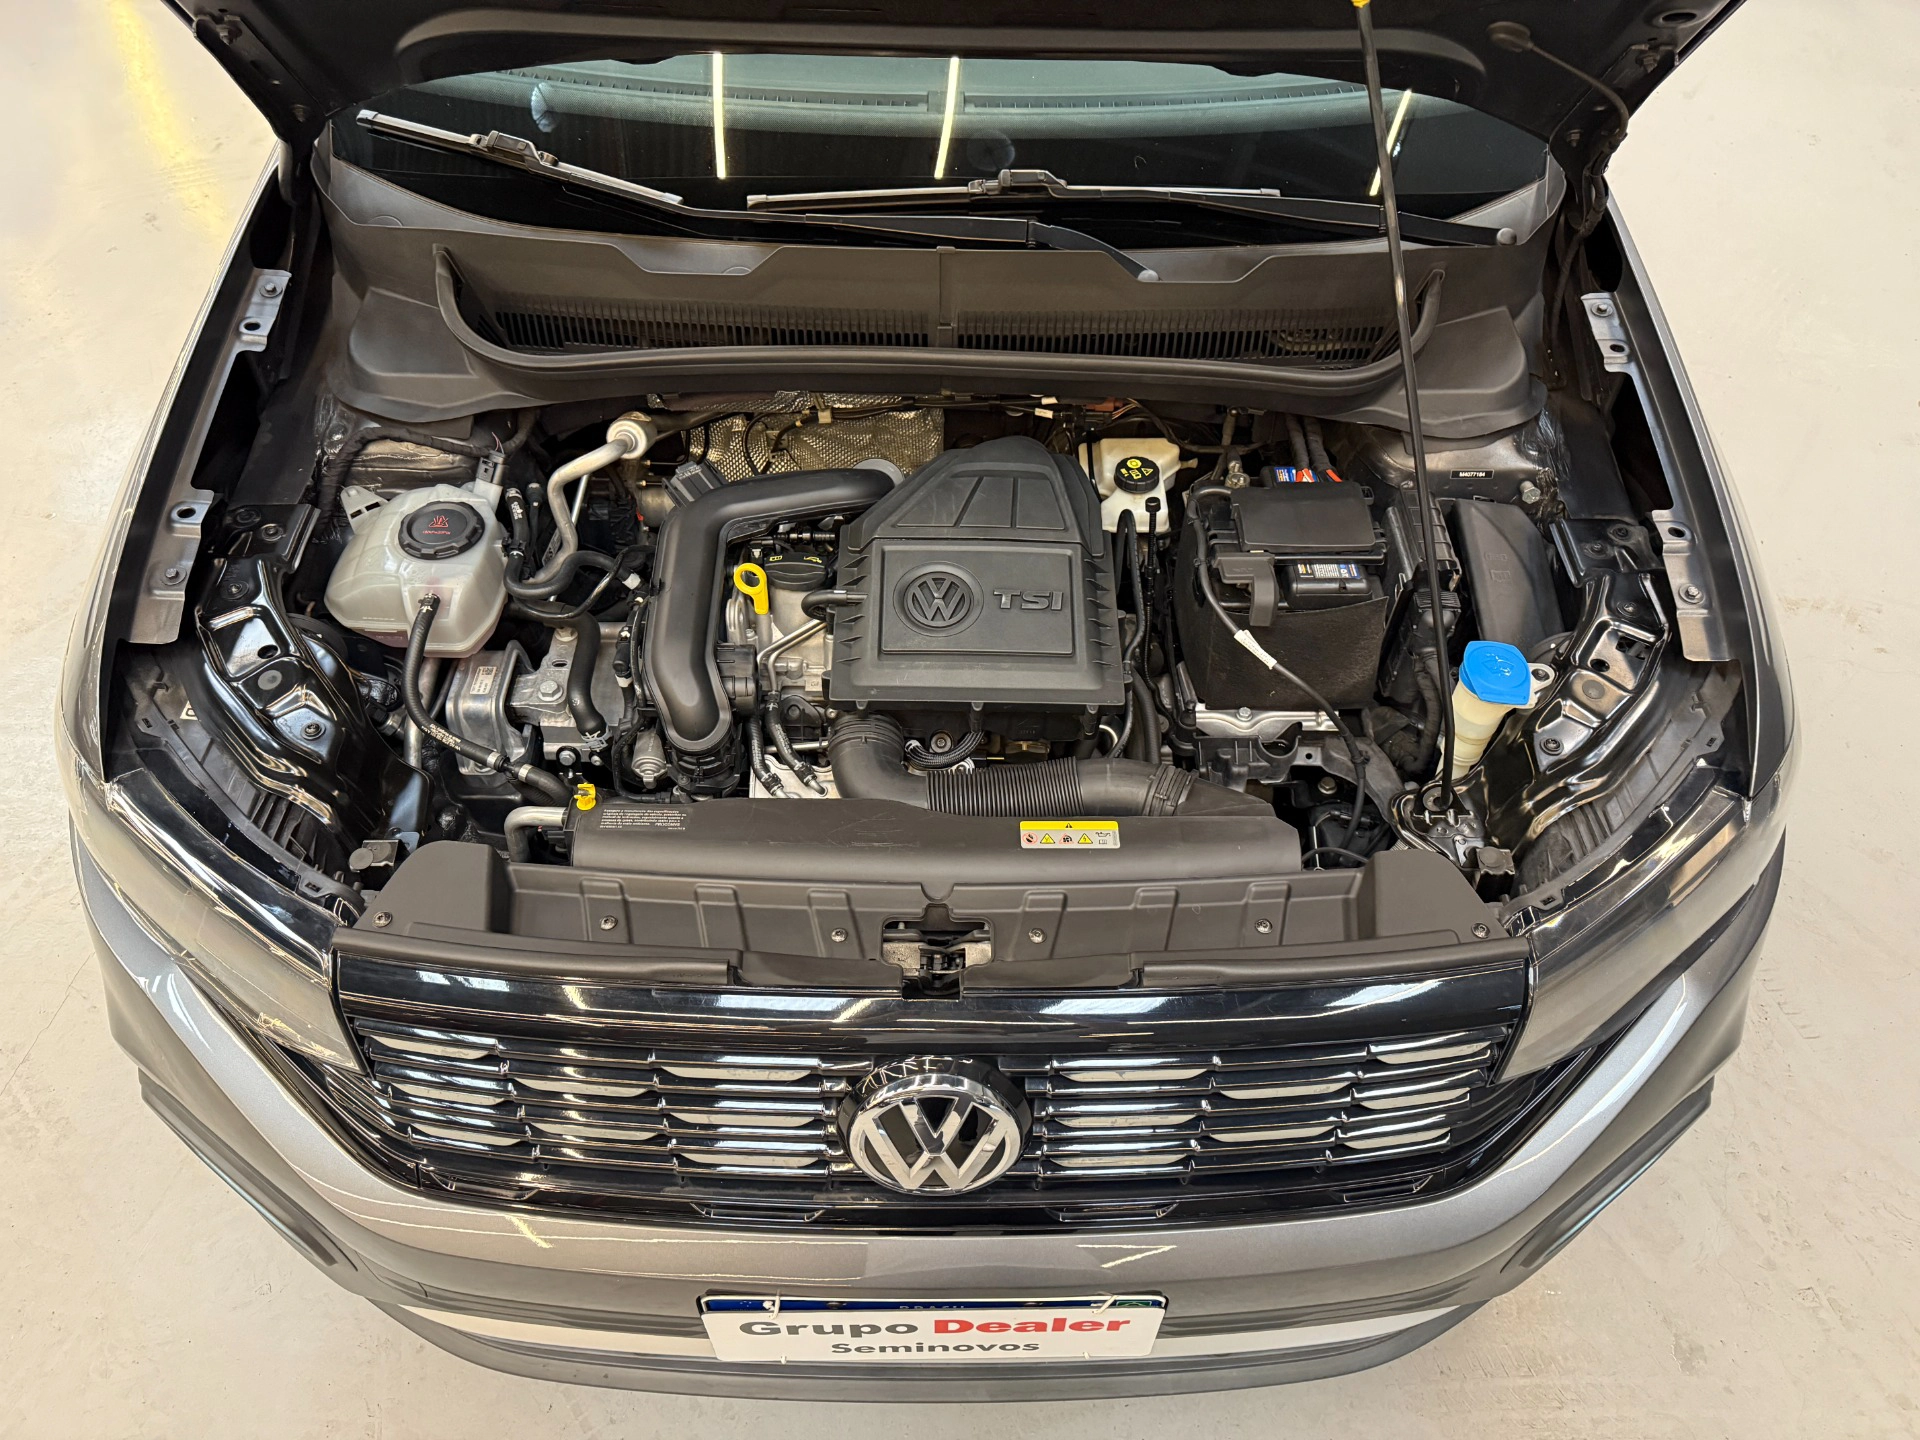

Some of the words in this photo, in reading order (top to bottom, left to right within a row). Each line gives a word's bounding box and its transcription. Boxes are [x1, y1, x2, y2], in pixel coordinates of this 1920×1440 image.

[906, 574, 971, 625] VW
[993, 588, 1064, 611] TSI
[851, 1084, 1020, 1195] VW
[738, 1321, 919, 1339] Grupo
[933, 1317, 1131, 1334] Dealer
[831, 1342, 1040, 1354] Seminovos
